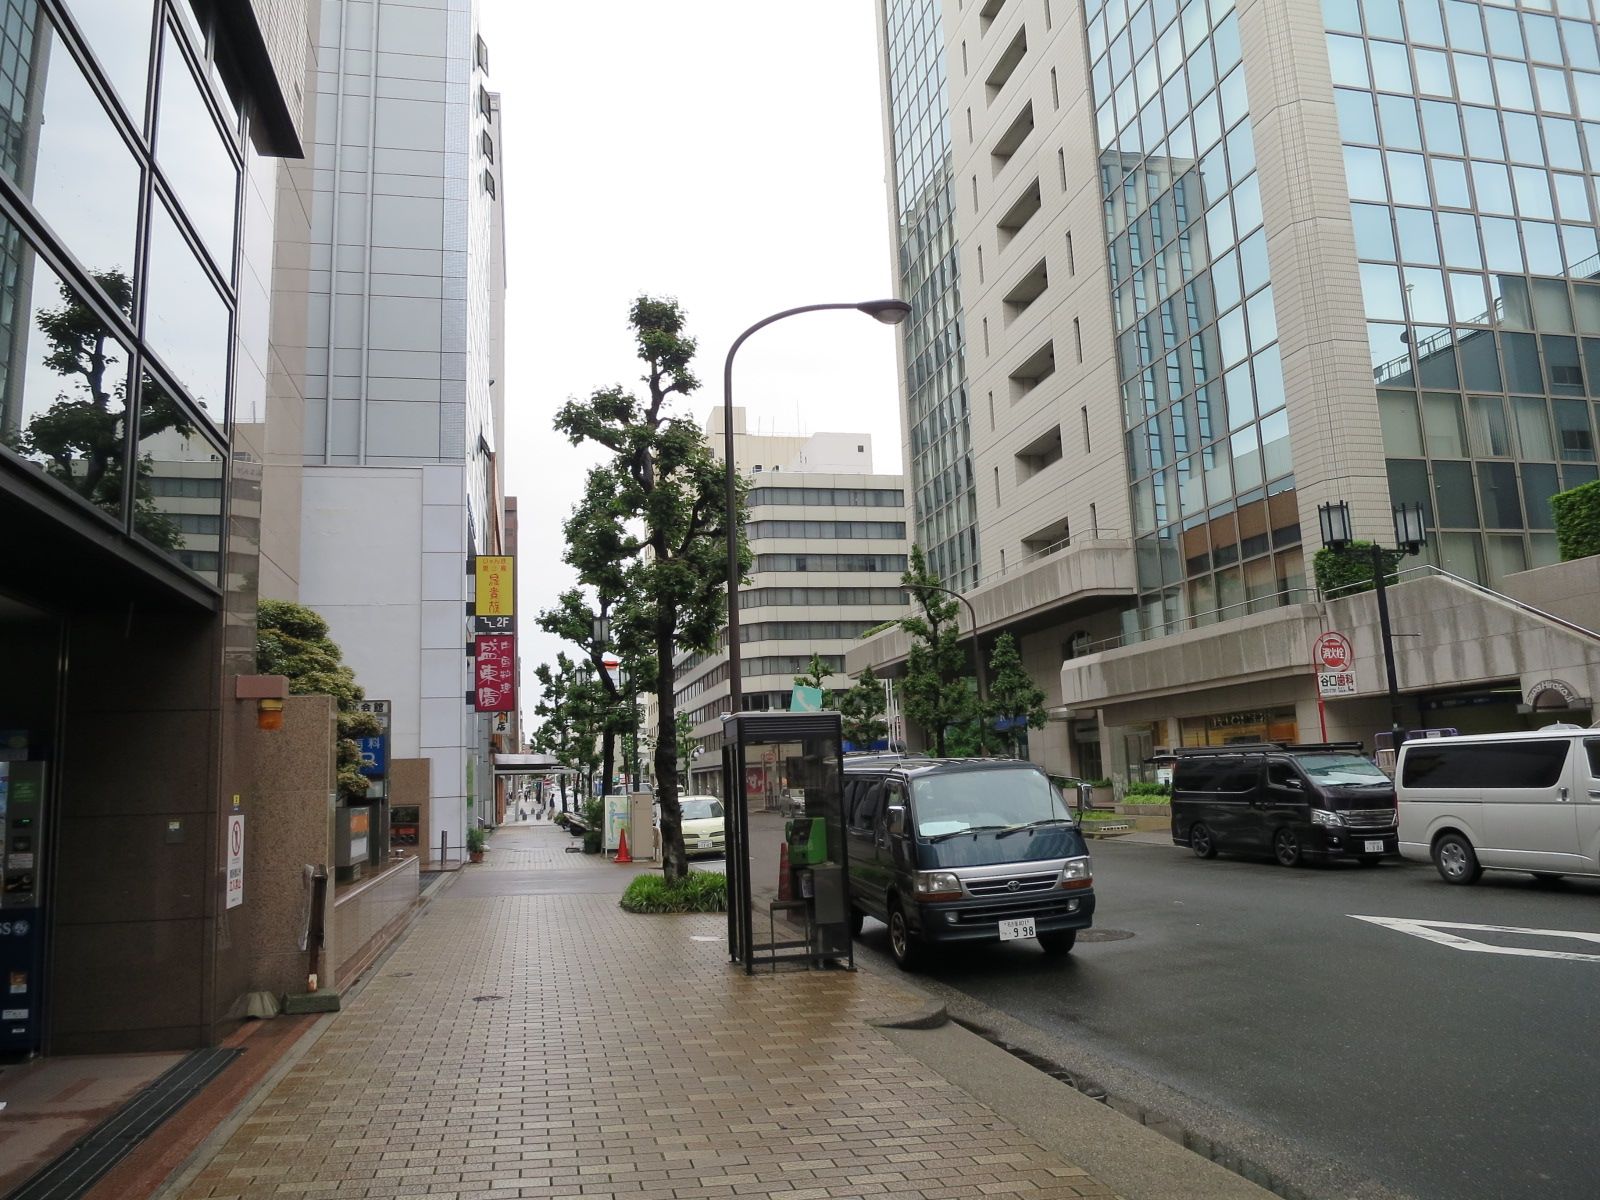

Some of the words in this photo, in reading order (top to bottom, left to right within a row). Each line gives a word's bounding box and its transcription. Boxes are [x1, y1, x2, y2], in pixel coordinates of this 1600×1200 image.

[497, 617, 510, 628] 2F
[1322, 647, 1345, 659] 消火栓
[1320, 674, 1354, 687] 谷口歯科
